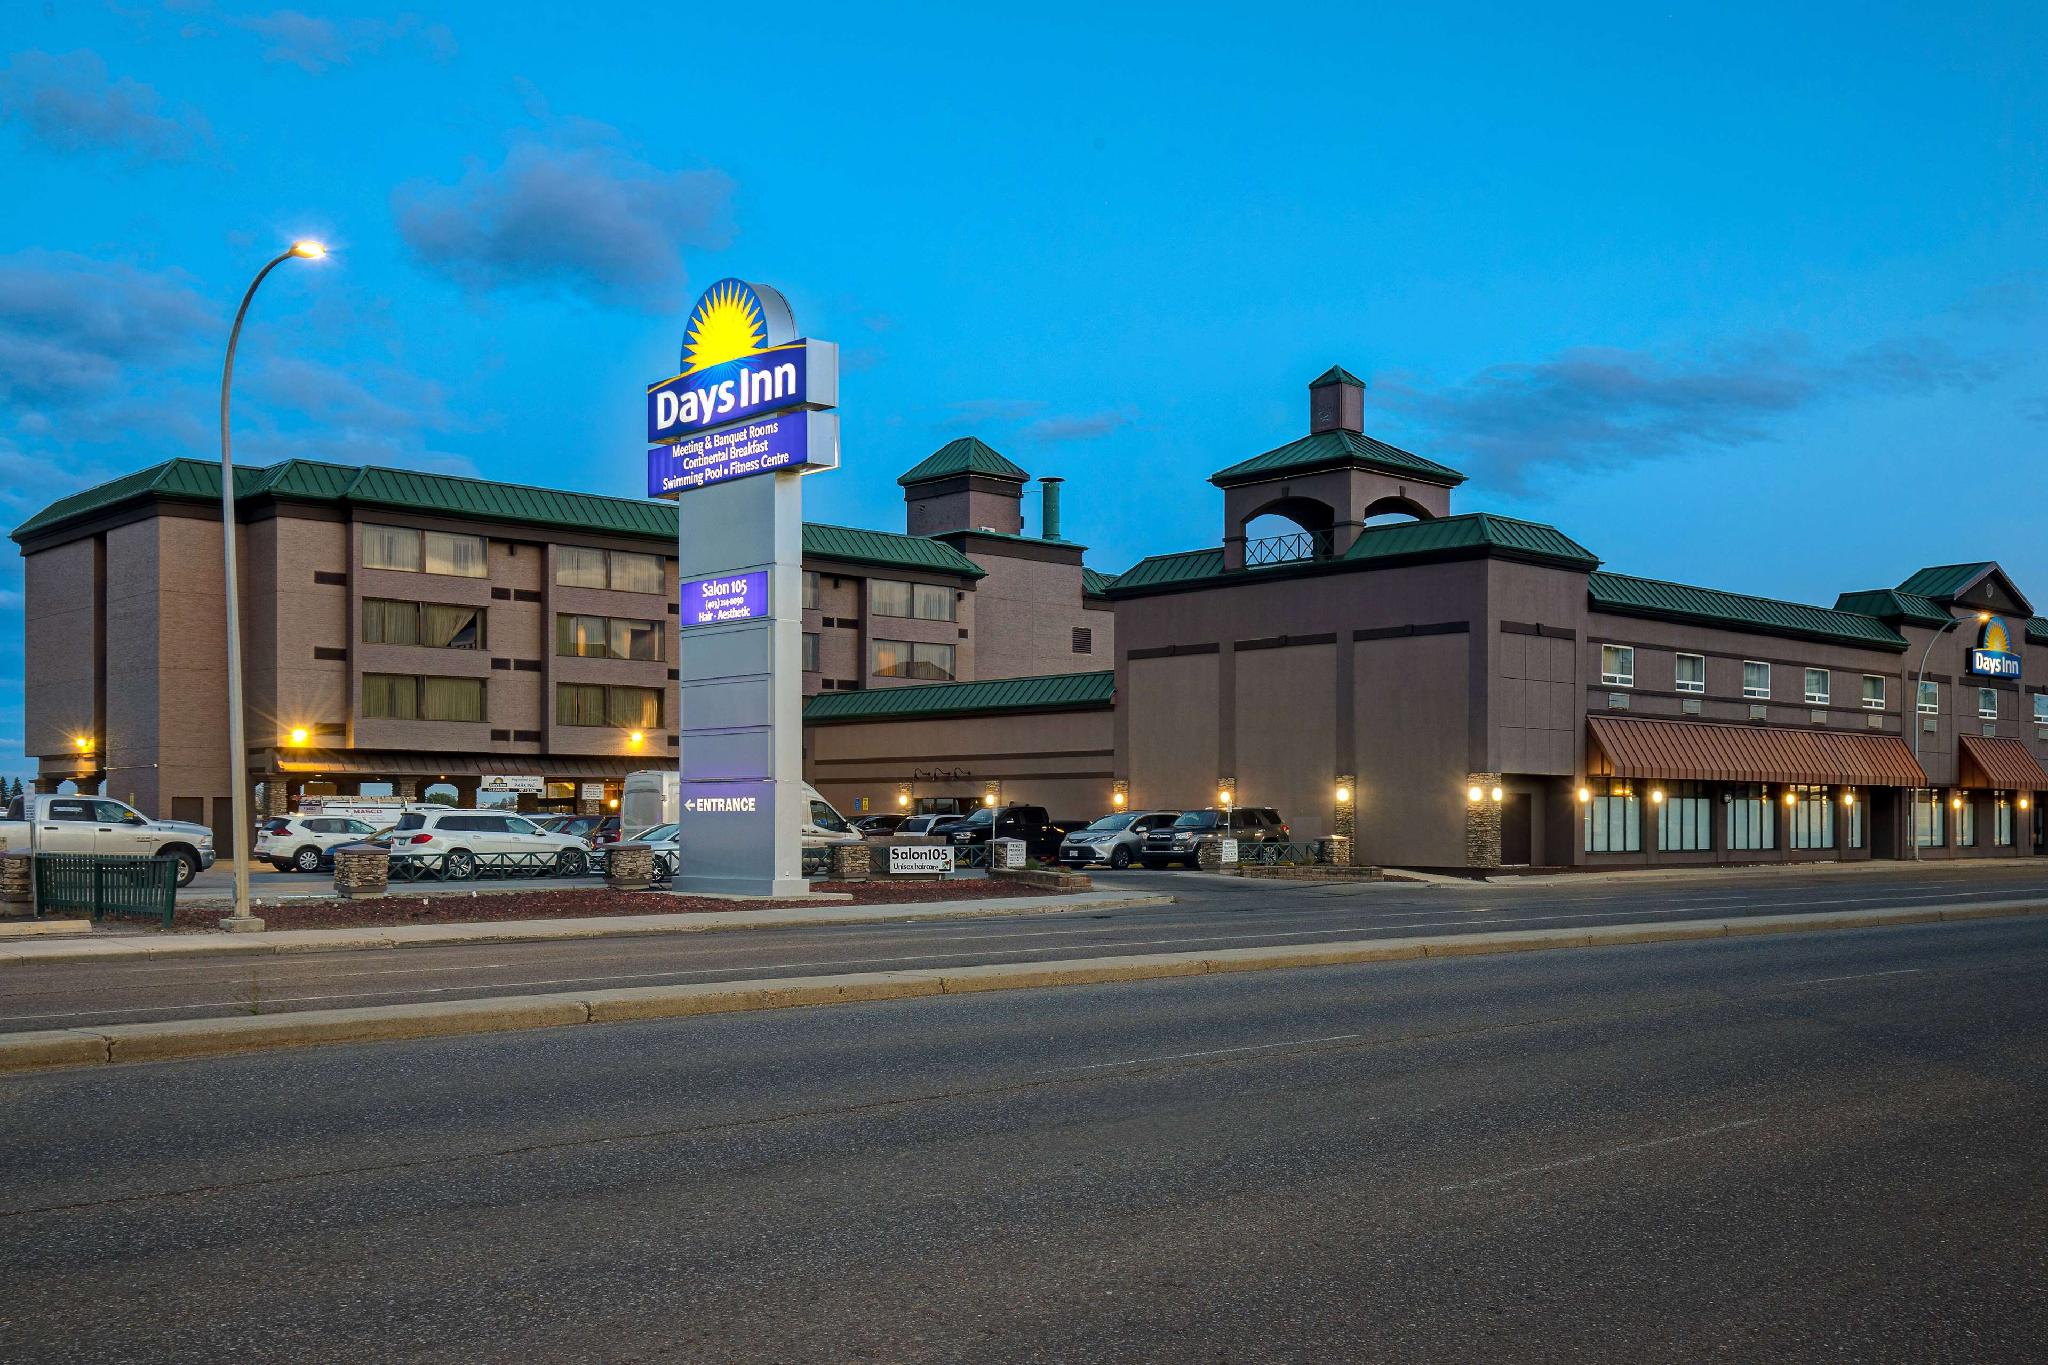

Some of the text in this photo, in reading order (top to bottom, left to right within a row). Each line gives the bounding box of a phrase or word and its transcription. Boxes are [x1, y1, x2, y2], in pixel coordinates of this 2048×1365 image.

[657, 362, 796, 430] Days Inn
[672, 422, 779, 458] Meeting & Banquet Rooms
[683, 440, 768, 469] Continental Breakfast
[662, 452, 789, 490] Swimming Pool Fitness Centre
[702, 579, 747, 597] Salon 105
[698, 611, 714, 622] Hair
[1975, 652, 2019, 675] Days Inn
[696, 797, 755, 812] ENTRANCE
